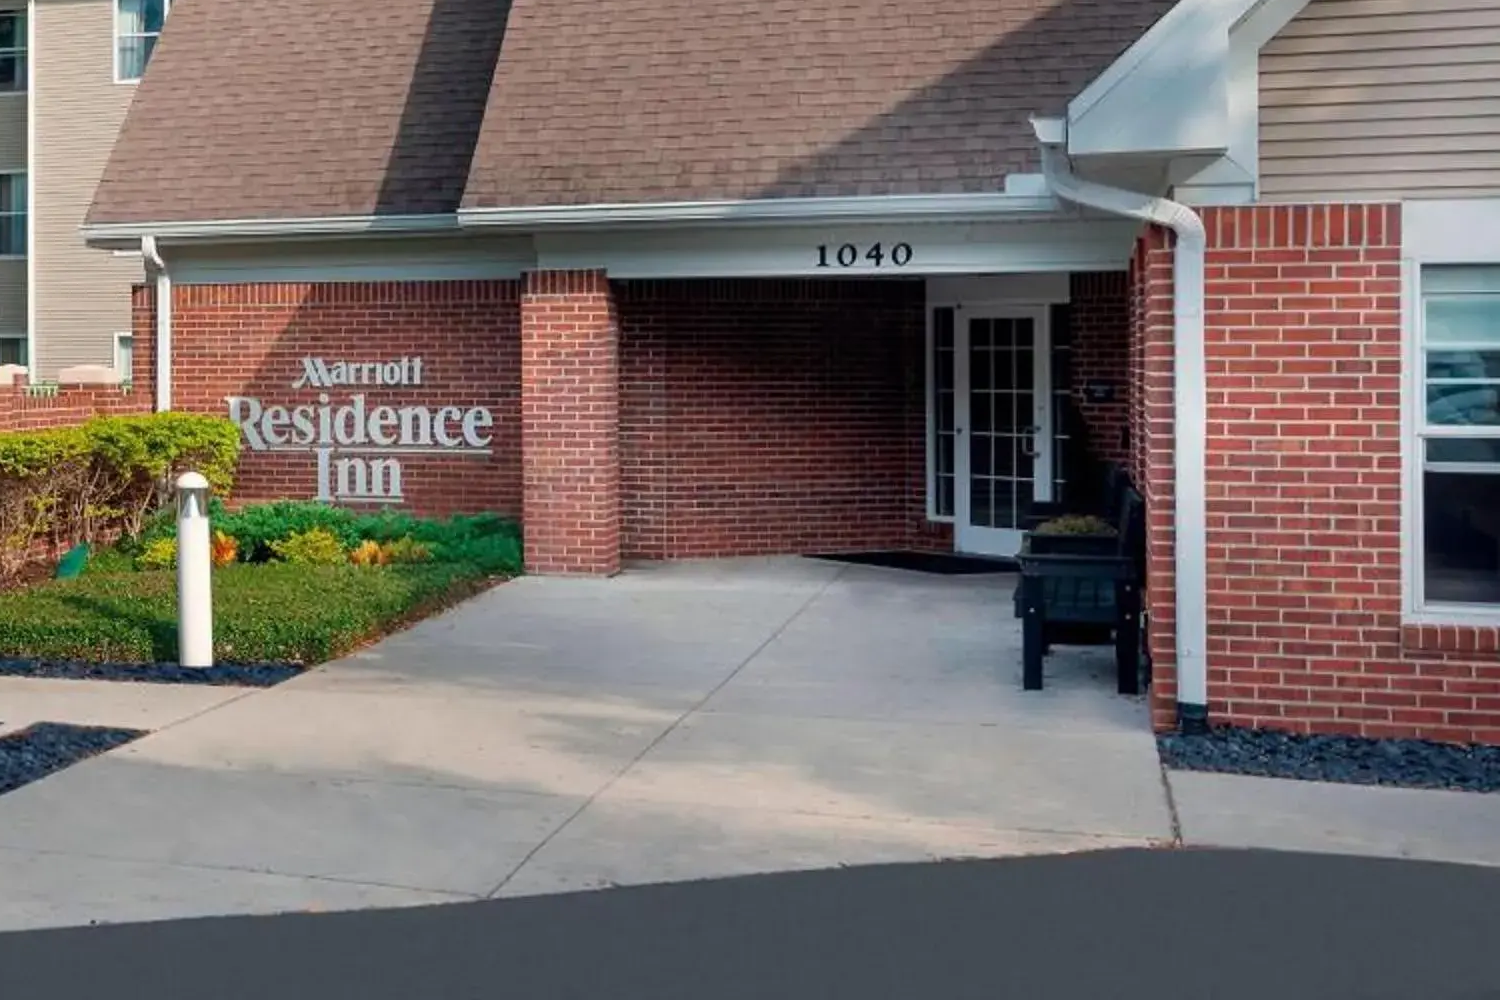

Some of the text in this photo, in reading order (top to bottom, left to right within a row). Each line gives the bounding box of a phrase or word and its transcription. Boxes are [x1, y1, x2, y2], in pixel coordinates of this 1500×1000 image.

[816, 241, 913, 267] 1040
[292, 355, 423, 388] Marriott
[225, 393, 493, 450] Residence
[316, 448, 404, 501] Inn
